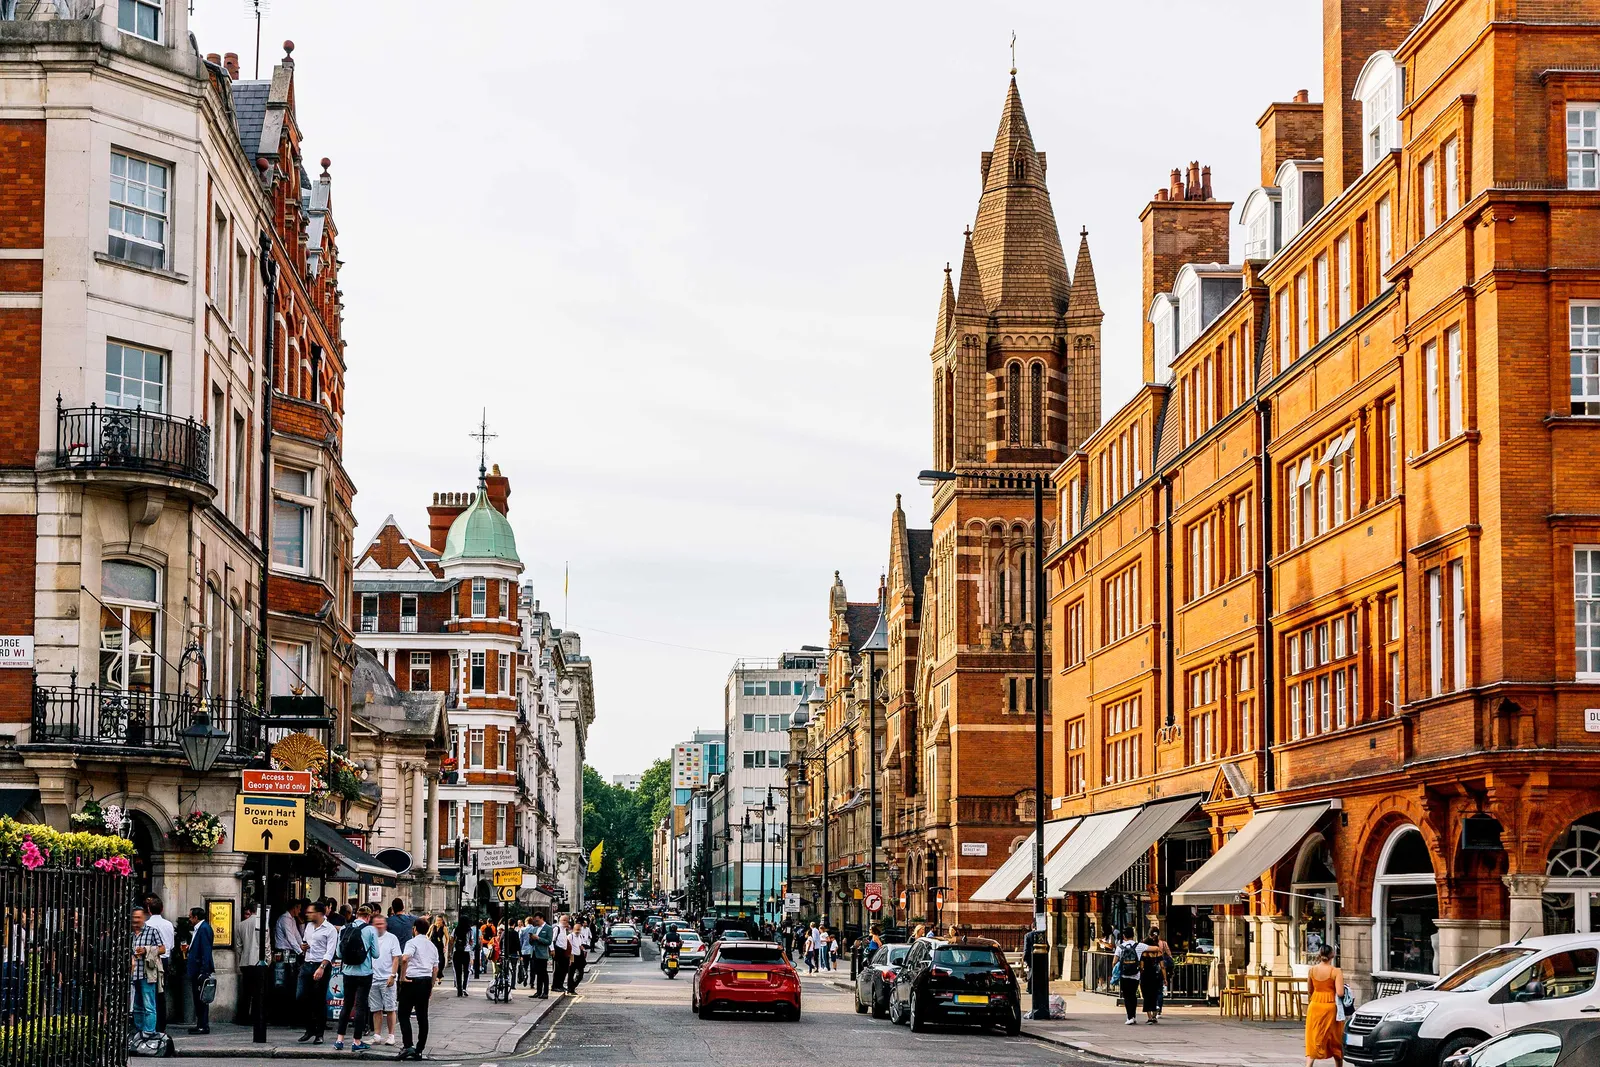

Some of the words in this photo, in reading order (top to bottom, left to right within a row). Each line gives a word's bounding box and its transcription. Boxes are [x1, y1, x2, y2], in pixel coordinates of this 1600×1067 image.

[248, 782, 273, 790] George
[244, 807, 273, 816] Brown
[276, 809, 295, 817] Hart
[252, 817, 288, 826] Gardens
